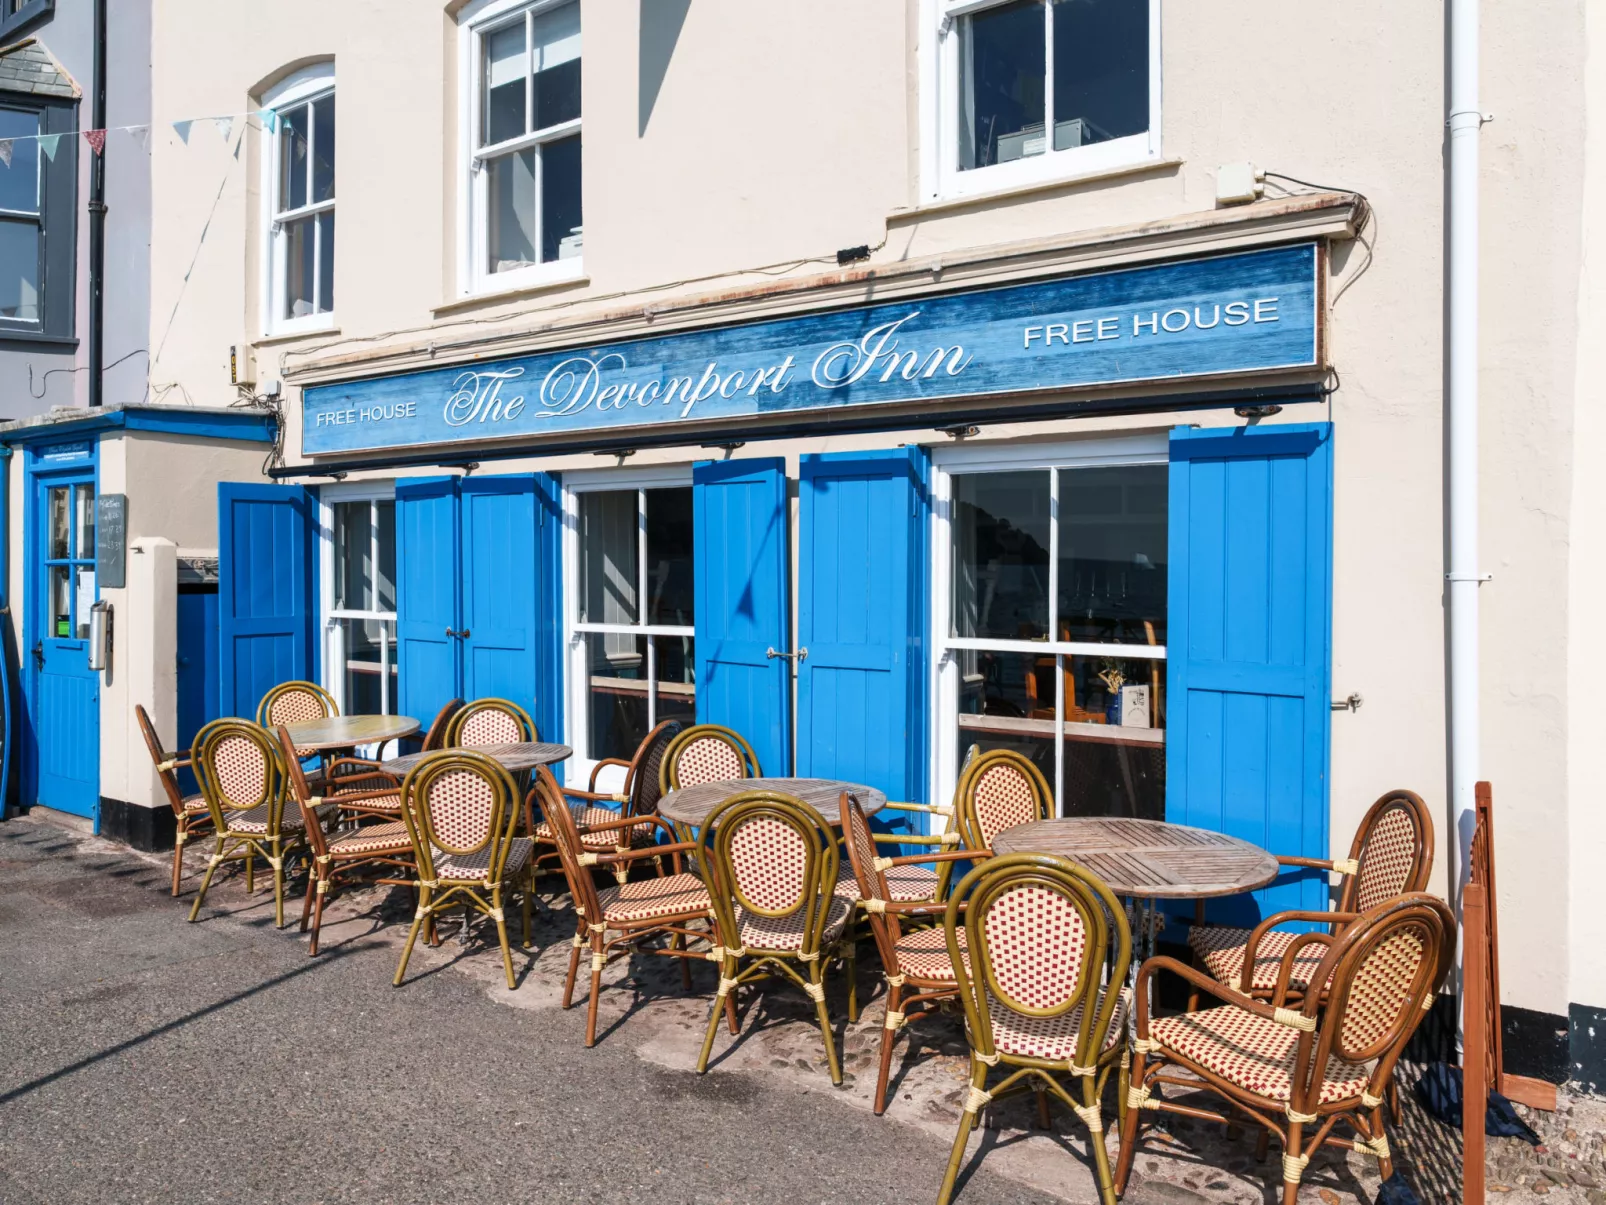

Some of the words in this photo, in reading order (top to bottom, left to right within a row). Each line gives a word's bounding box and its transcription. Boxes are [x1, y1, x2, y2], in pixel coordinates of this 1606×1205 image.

[1024, 316, 1120, 349] FREE
[1132, 297, 1280, 338] HOUSE
[443, 366, 526, 427] The
[534, 353, 796, 418] Devonport
[811, 311, 974, 388] Inn
[316, 408, 356, 426] FREE
[359, 401, 417, 422] HOUSE
